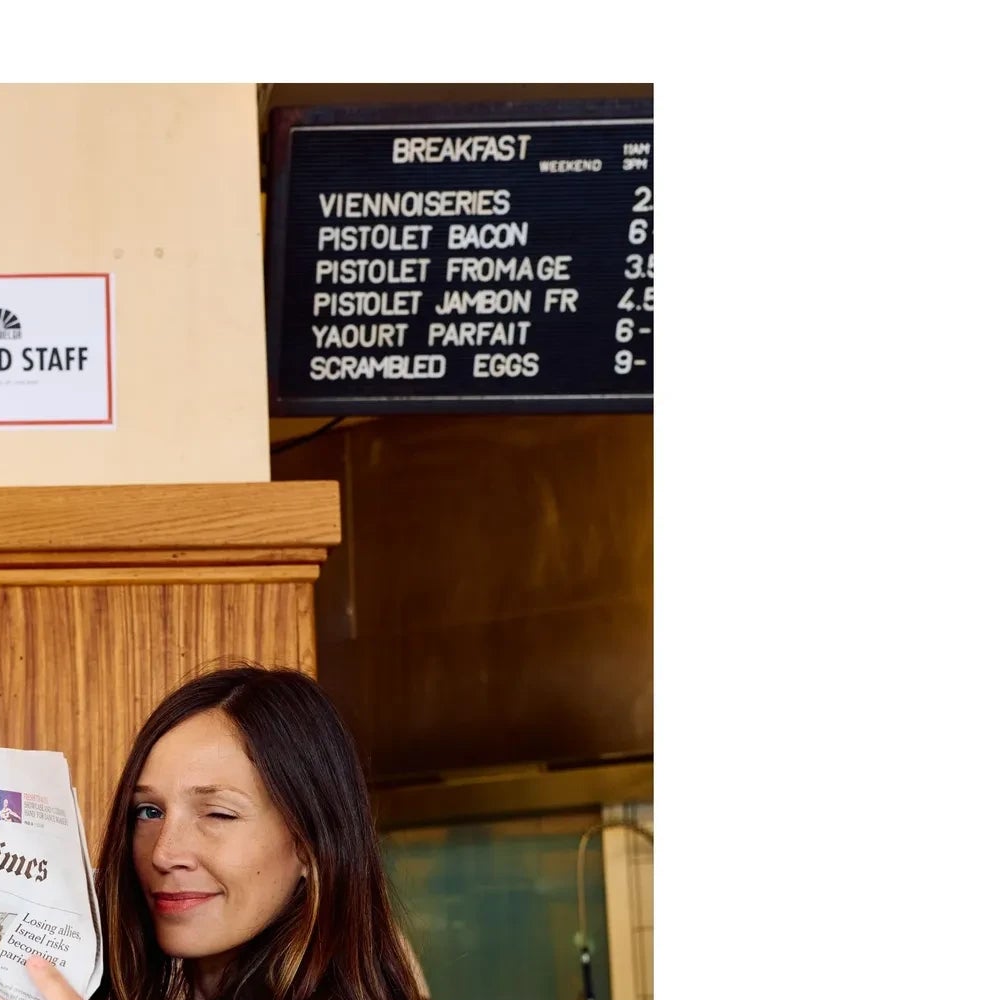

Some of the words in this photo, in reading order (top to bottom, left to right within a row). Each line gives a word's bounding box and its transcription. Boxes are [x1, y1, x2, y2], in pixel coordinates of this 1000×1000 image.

[392, 135, 531, 164] BREAKFAST
[539, 159, 602, 173] WEEKEND
[319, 189, 511, 218] VIENNOISERIES
[318, 225, 433, 252] PISTOLET
[448, 222, 528, 250] BACON
[315, 258, 431, 285] PISTOLET
[446, 255, 573, 282] FROMAGE
[313, 290, 423, 317] PISTOLET
[435, 290, 531, 315] JAMBON
[543, 288, 579, 313] FR
[312, 323, 409, 349] YAOURT
[428, 321, 532, 347] PARFAIT
[23, 347, 88, 371] STAFF
[310, 355, 446, 381] SCRAMBLED
[473, 352, 540, 378] EGGS
[15, 923, 46, 945] Israel
[46, 937, 70, 952] risks
[22, 912, 57, 935] Losing
[58, 924, 81, 940] allies,
